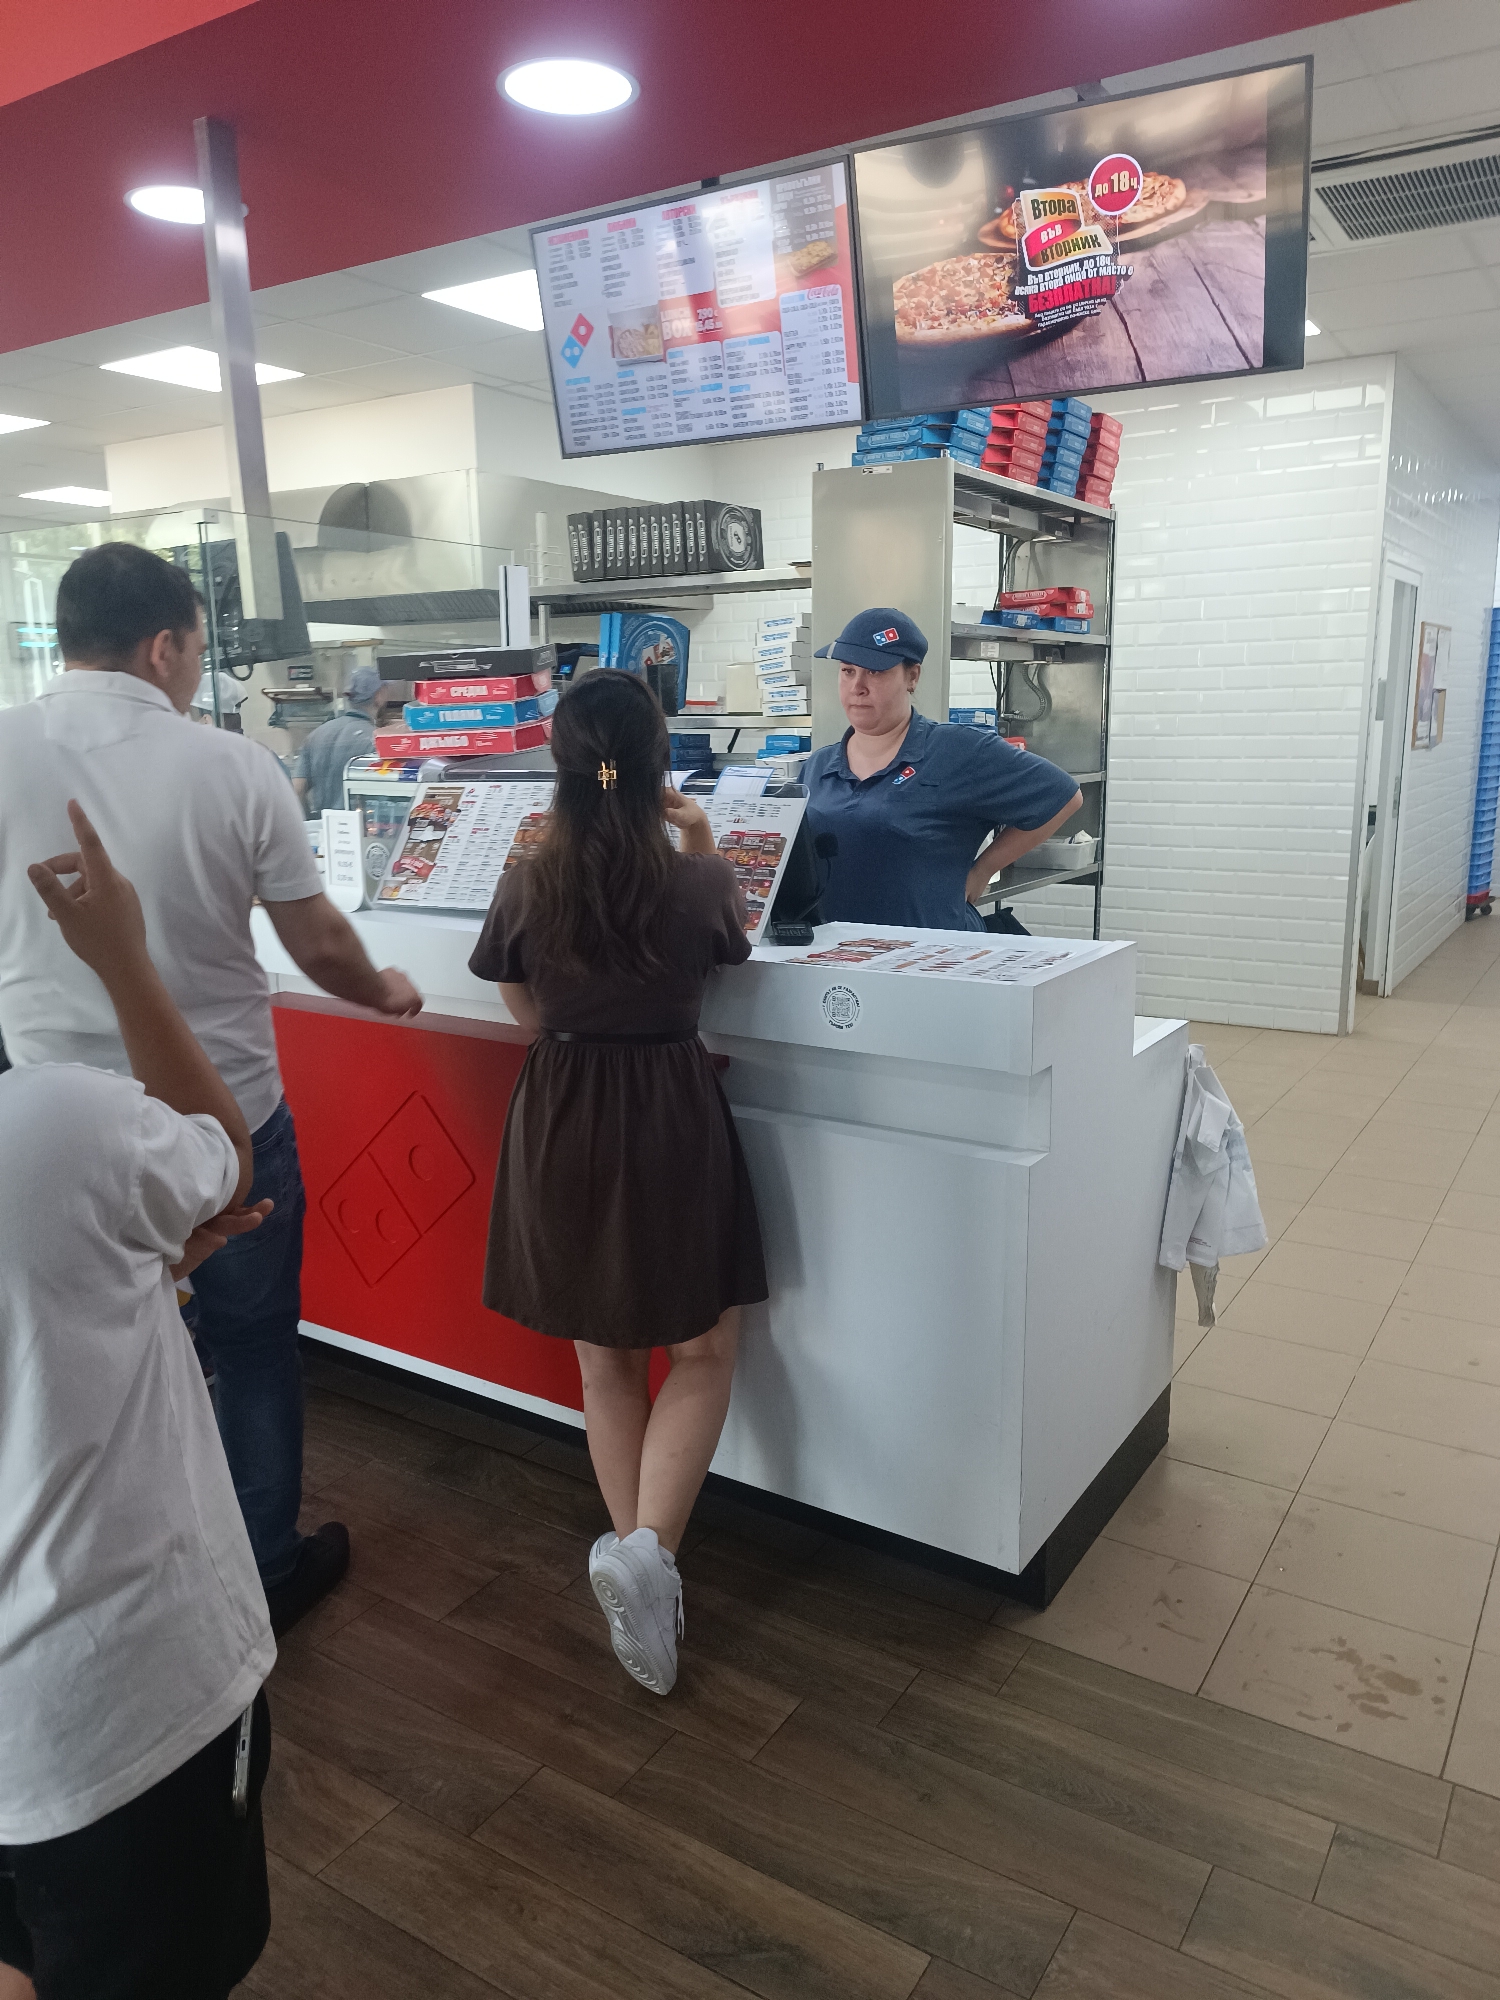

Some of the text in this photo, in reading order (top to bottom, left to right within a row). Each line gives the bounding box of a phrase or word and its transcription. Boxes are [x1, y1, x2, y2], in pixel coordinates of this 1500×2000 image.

[1031, 198, 1076, 220] Втора
[1028, 275, 1117, 313] БЕЗПЛАТНА!
[662, 318, 693, 340] BOX
